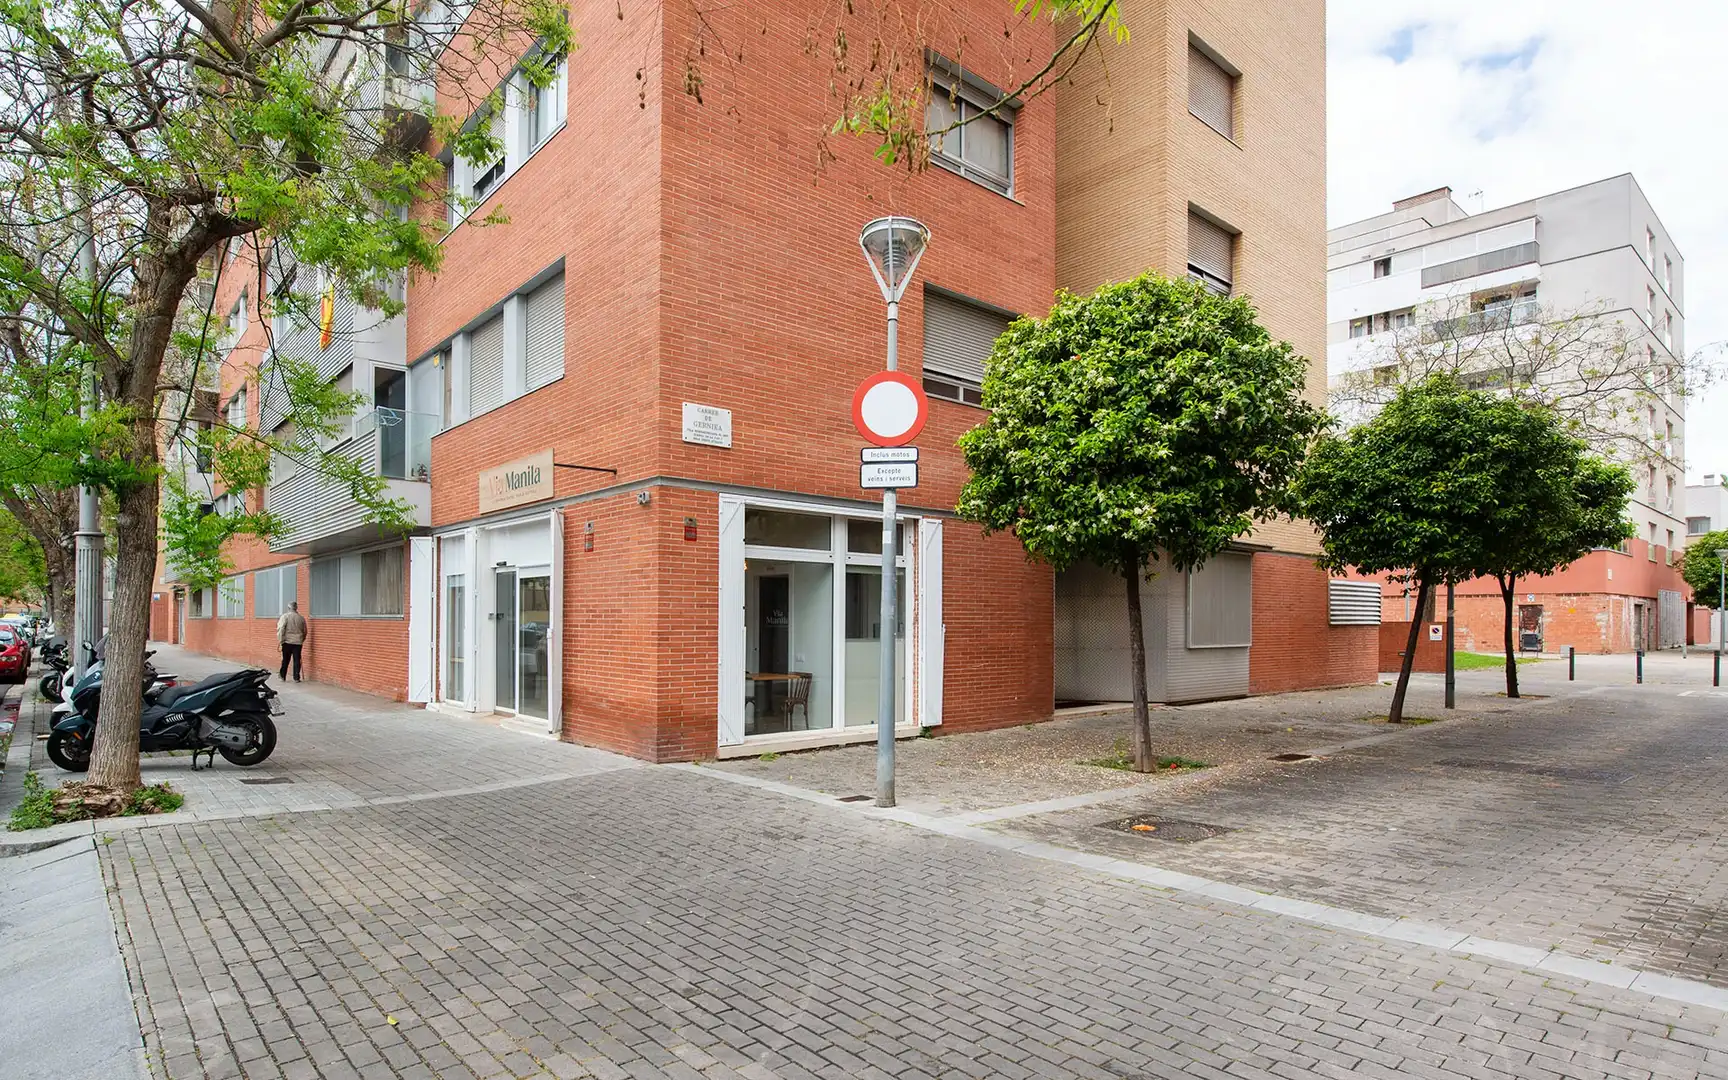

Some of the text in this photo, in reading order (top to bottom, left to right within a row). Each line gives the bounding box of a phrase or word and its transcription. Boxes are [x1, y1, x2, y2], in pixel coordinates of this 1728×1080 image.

[697, 408, 719, 416] CARRER
[693, 421, 723, 431] GERNIKA
[505, 465, 541, 493] Manila
